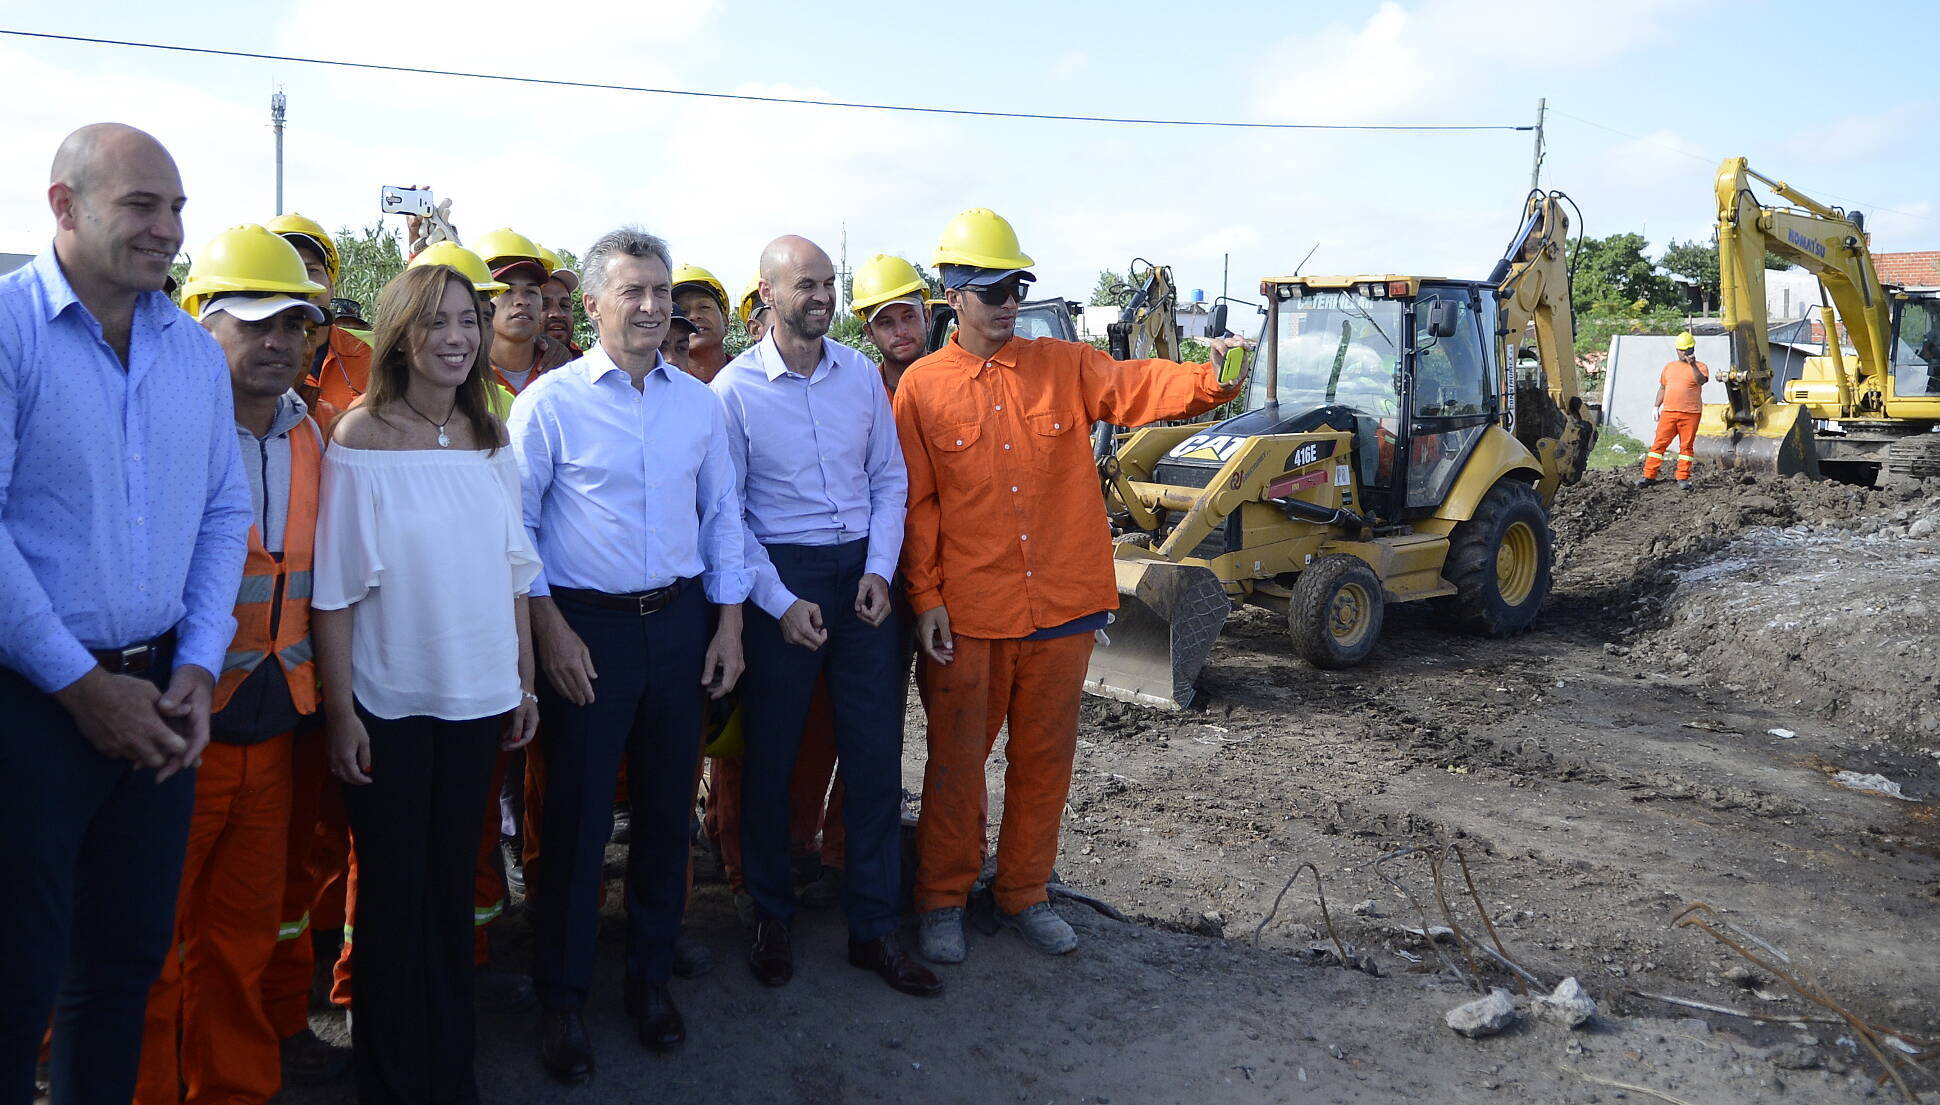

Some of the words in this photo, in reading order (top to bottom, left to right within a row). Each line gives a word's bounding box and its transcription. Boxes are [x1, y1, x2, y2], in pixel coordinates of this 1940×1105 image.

[1788, 228, 1826, 258] KOMATSU
[1169, 435, 1247, 461] CAT
[1294, 444, 1317, 467] 416E
